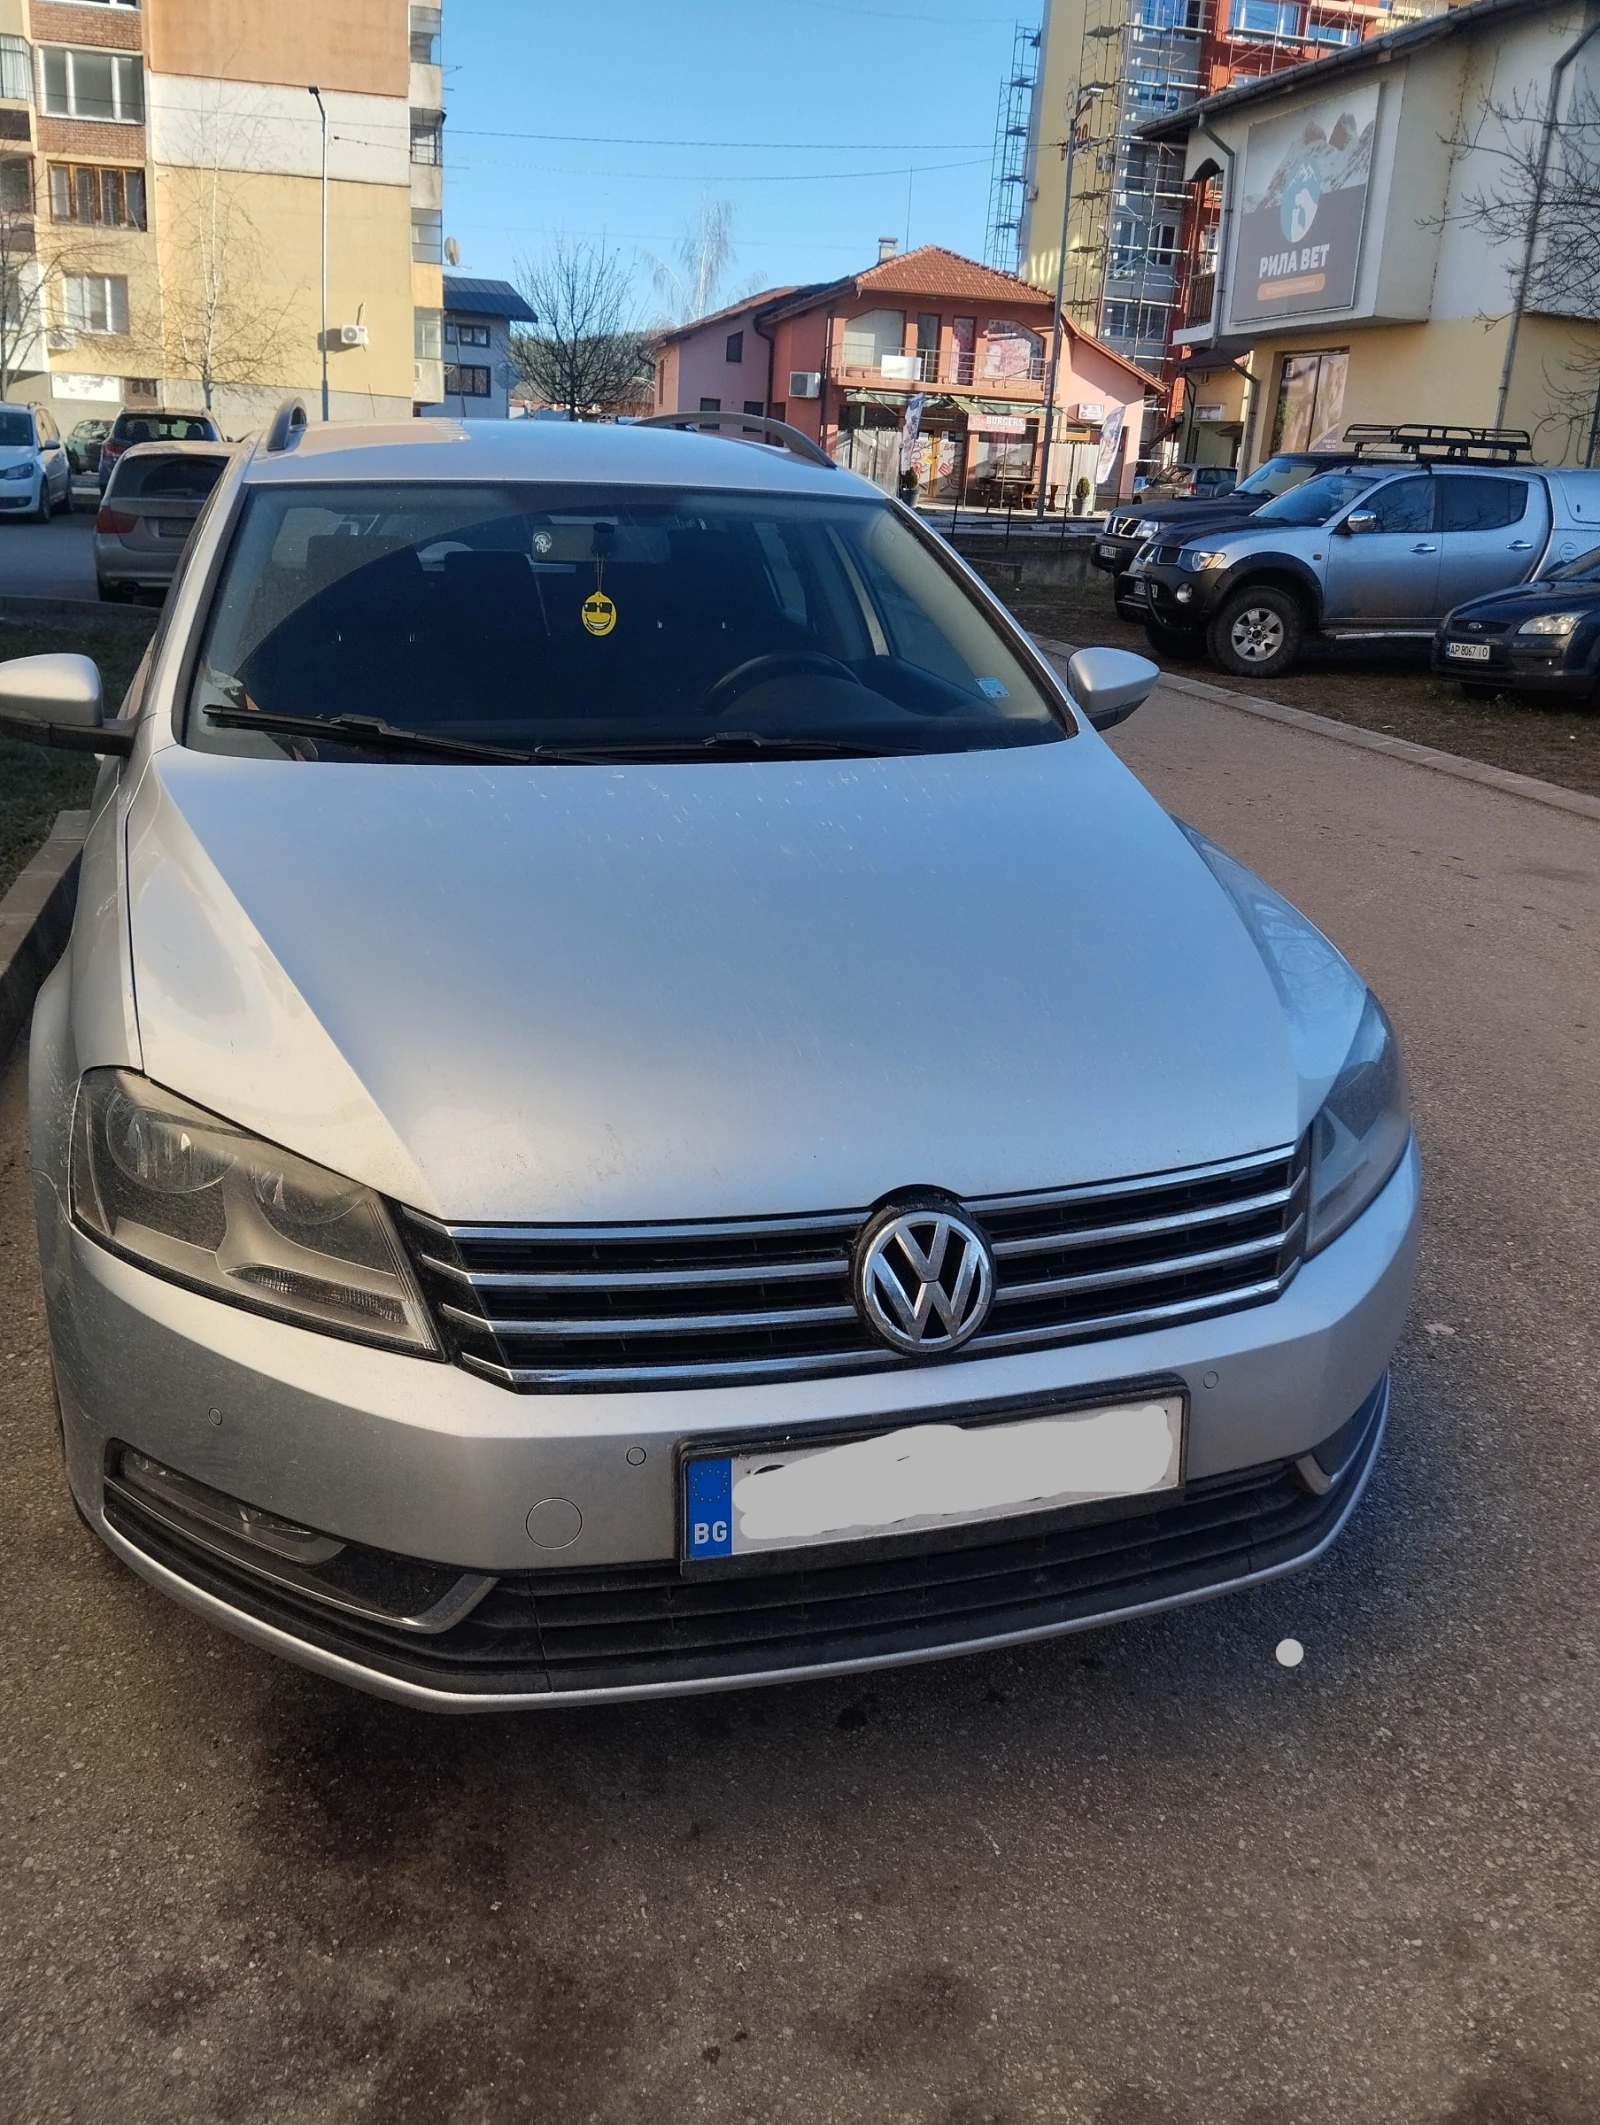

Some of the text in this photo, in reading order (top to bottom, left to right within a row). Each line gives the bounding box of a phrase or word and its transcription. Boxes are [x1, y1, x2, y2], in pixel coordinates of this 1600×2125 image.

[1259, 243, 1330, 279] РИЛА ВЕТ
[986, 415, 1024, 427] BURGERS
[1450, 644, 1460, 655] AP
[694, 1520, 727, 1545] BG
